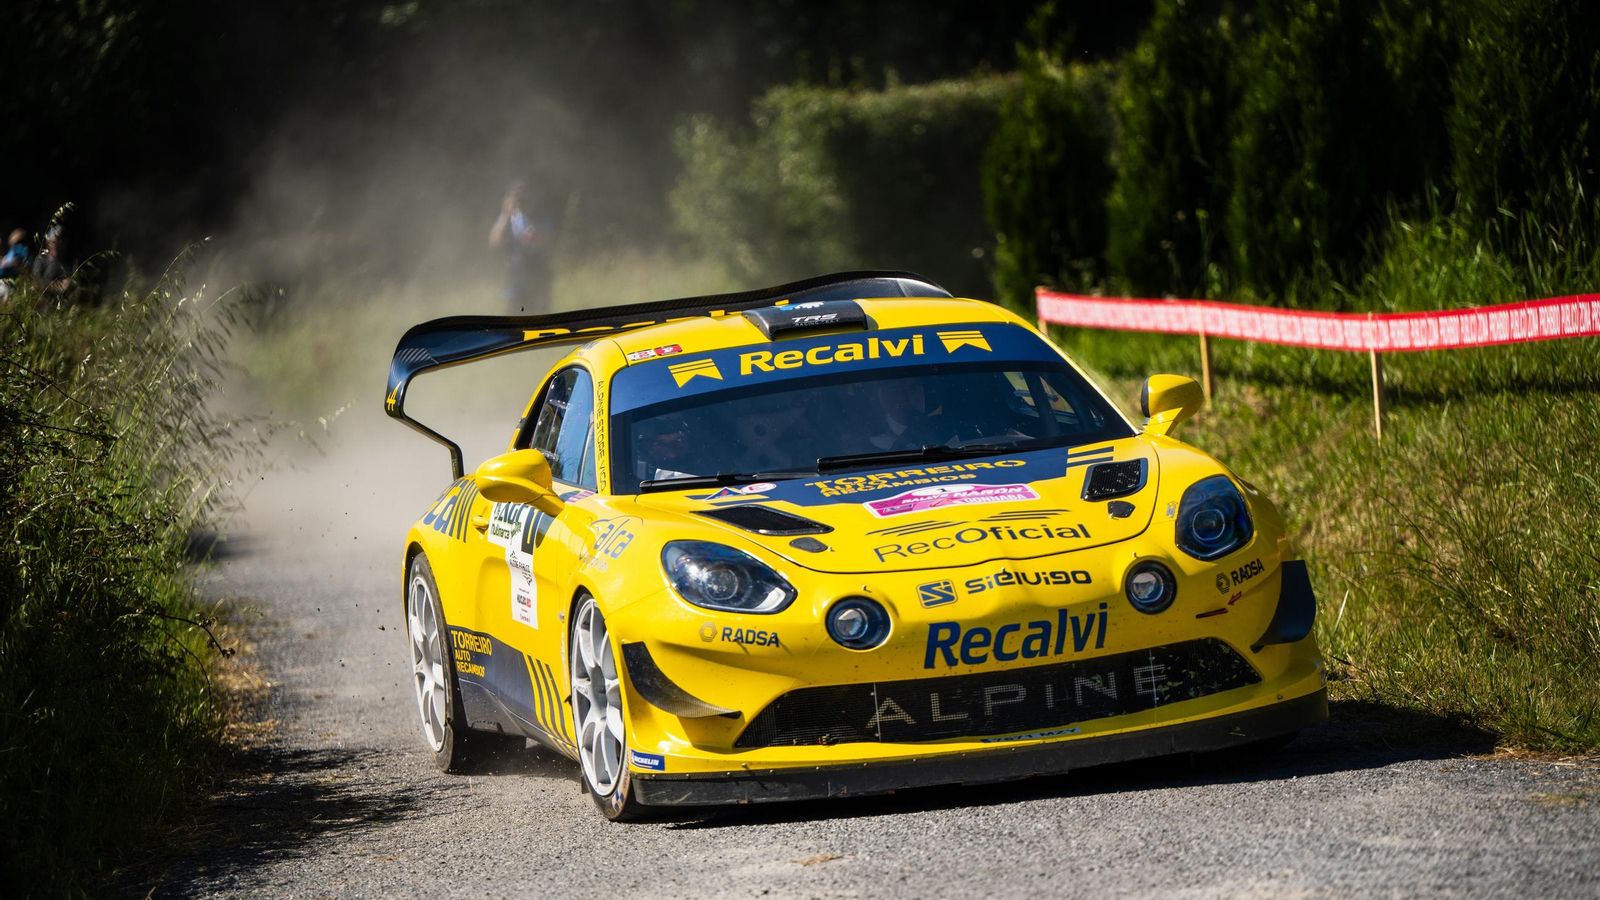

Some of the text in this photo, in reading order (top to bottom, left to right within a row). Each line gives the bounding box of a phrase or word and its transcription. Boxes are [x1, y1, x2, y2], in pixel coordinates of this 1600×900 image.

[740, 334, 925, 376] Recalvi
[804, 460, 1026, 489] TORREIRO
[822, 473, 977, 498] RECAMBIOS
[873, 524, 1092, 563] RecOficial
[1230, 558, 1265, 587] RADSA
[450, 630, 493, 656] TORREIRO
[721, 626, 780, 648] RADSA
[923, 602, 1108, 670] Recalvi
[455, 649, 471, 662] AUTO
[456, 661, 486, 678] RECAMBIOS
[865, 663, 1168, 730] ALPINE
